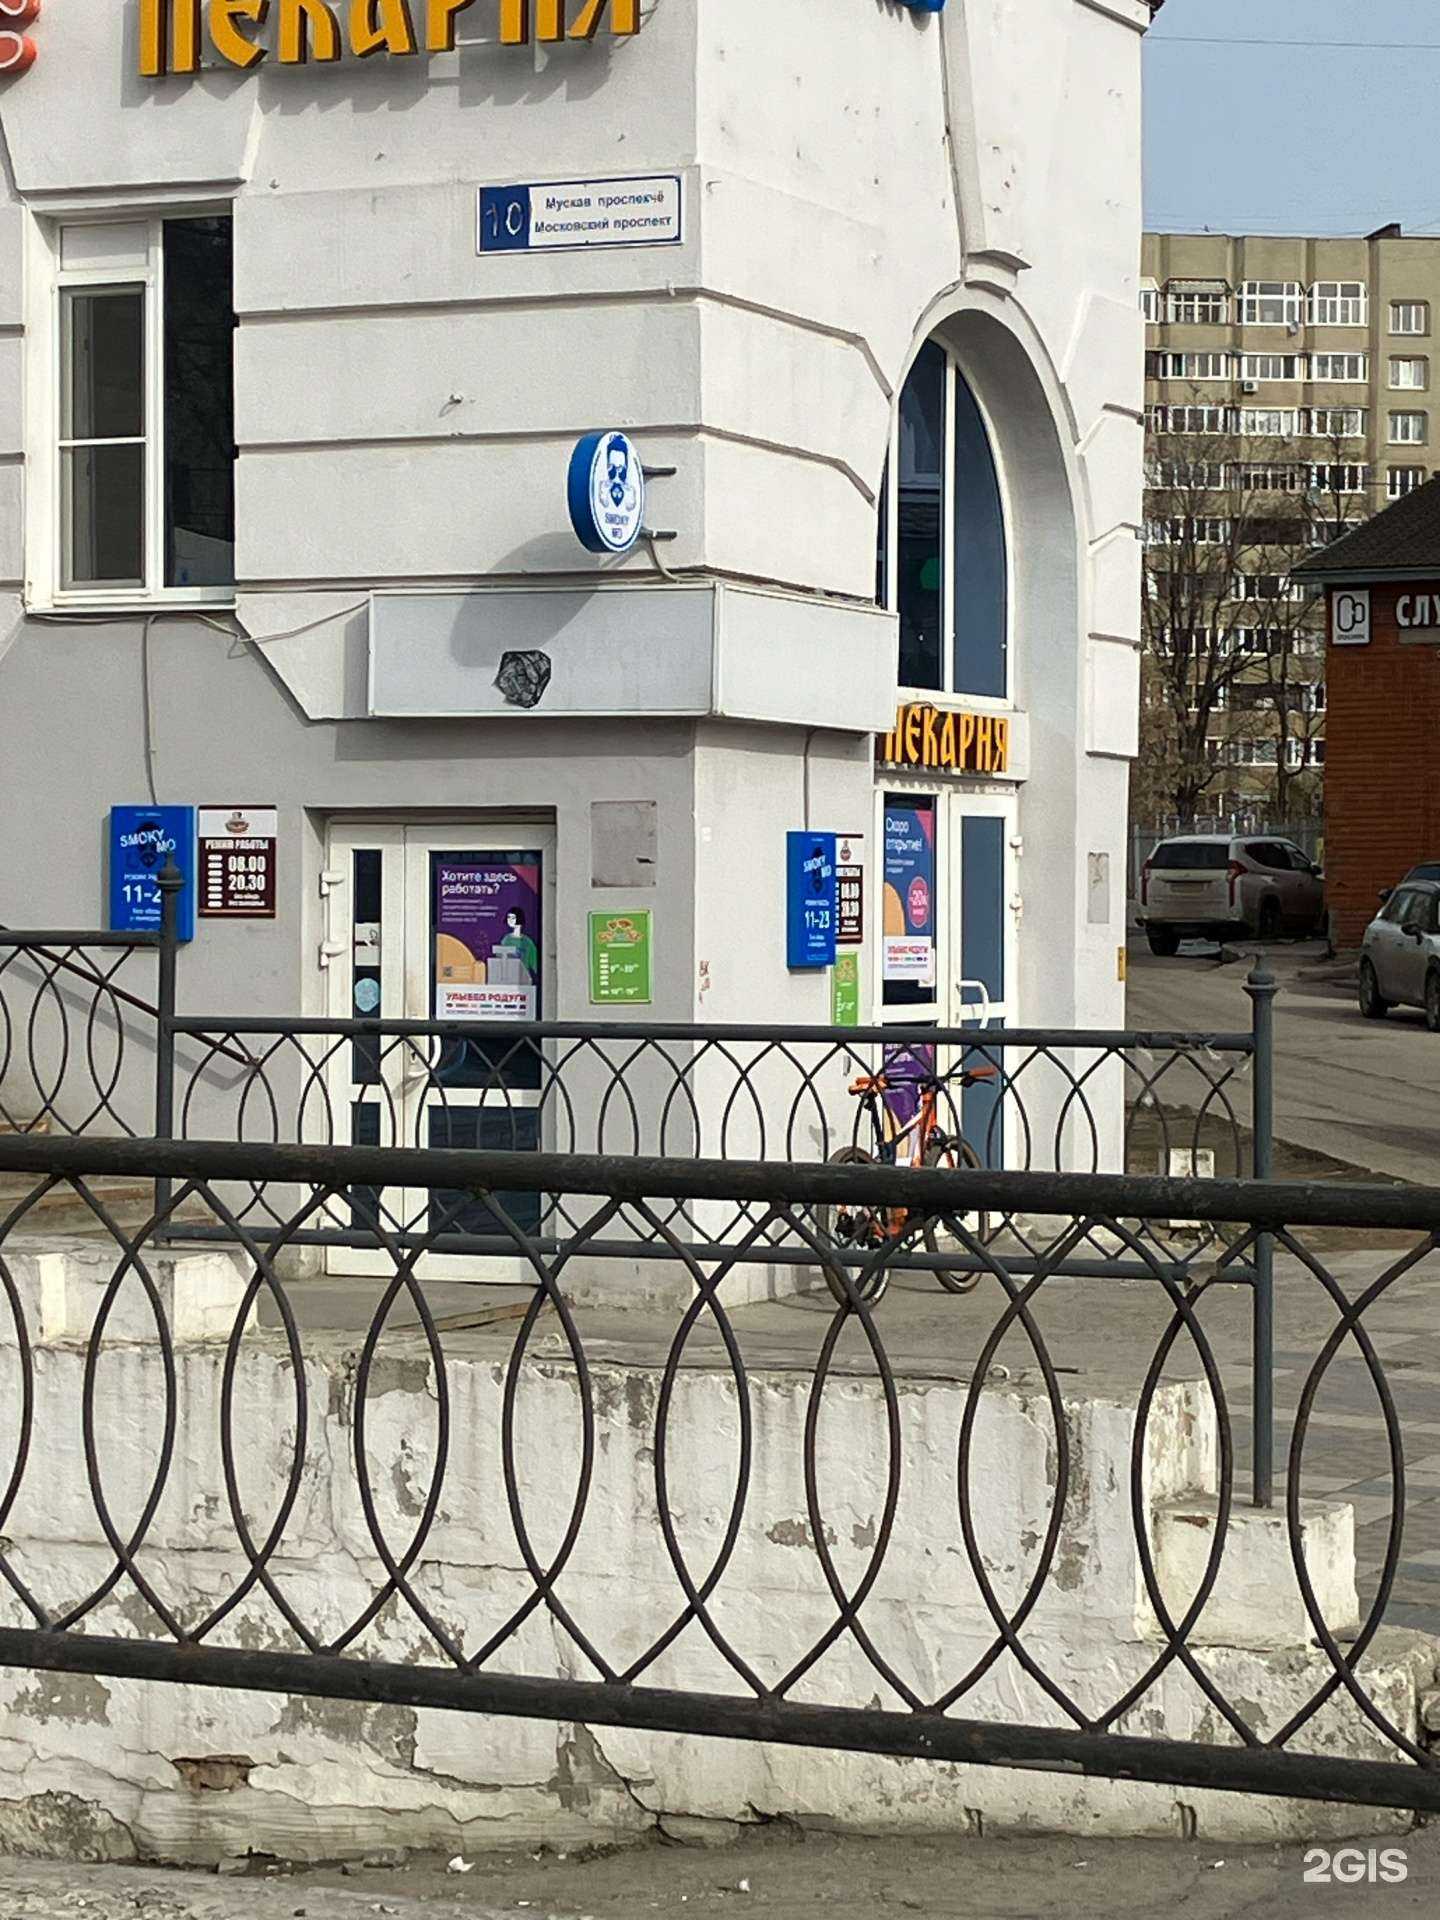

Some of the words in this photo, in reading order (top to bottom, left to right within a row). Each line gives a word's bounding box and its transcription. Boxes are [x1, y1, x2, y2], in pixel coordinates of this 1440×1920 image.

[545, 196, 592, 212] Мускав
[486, 201, 524, 237] 10
[535, 218, 609, 233] Московский
[613, 215, 672, 231] проспект
[885, 704, 1008, 772] ПЕКАРНЯ
[120, 829, 164, 848] SMOKY
[156, 838, 176, 853] MO
[228, 856, 266, 873] 08.00
[228, 874, 266, 891] 20.30
[441, 870, 482, 882] Хотите
[484, 872, 518, 883] здесь
[442, 883, 500, 896] работать?
[805, 910, 830, 928] 11-23
